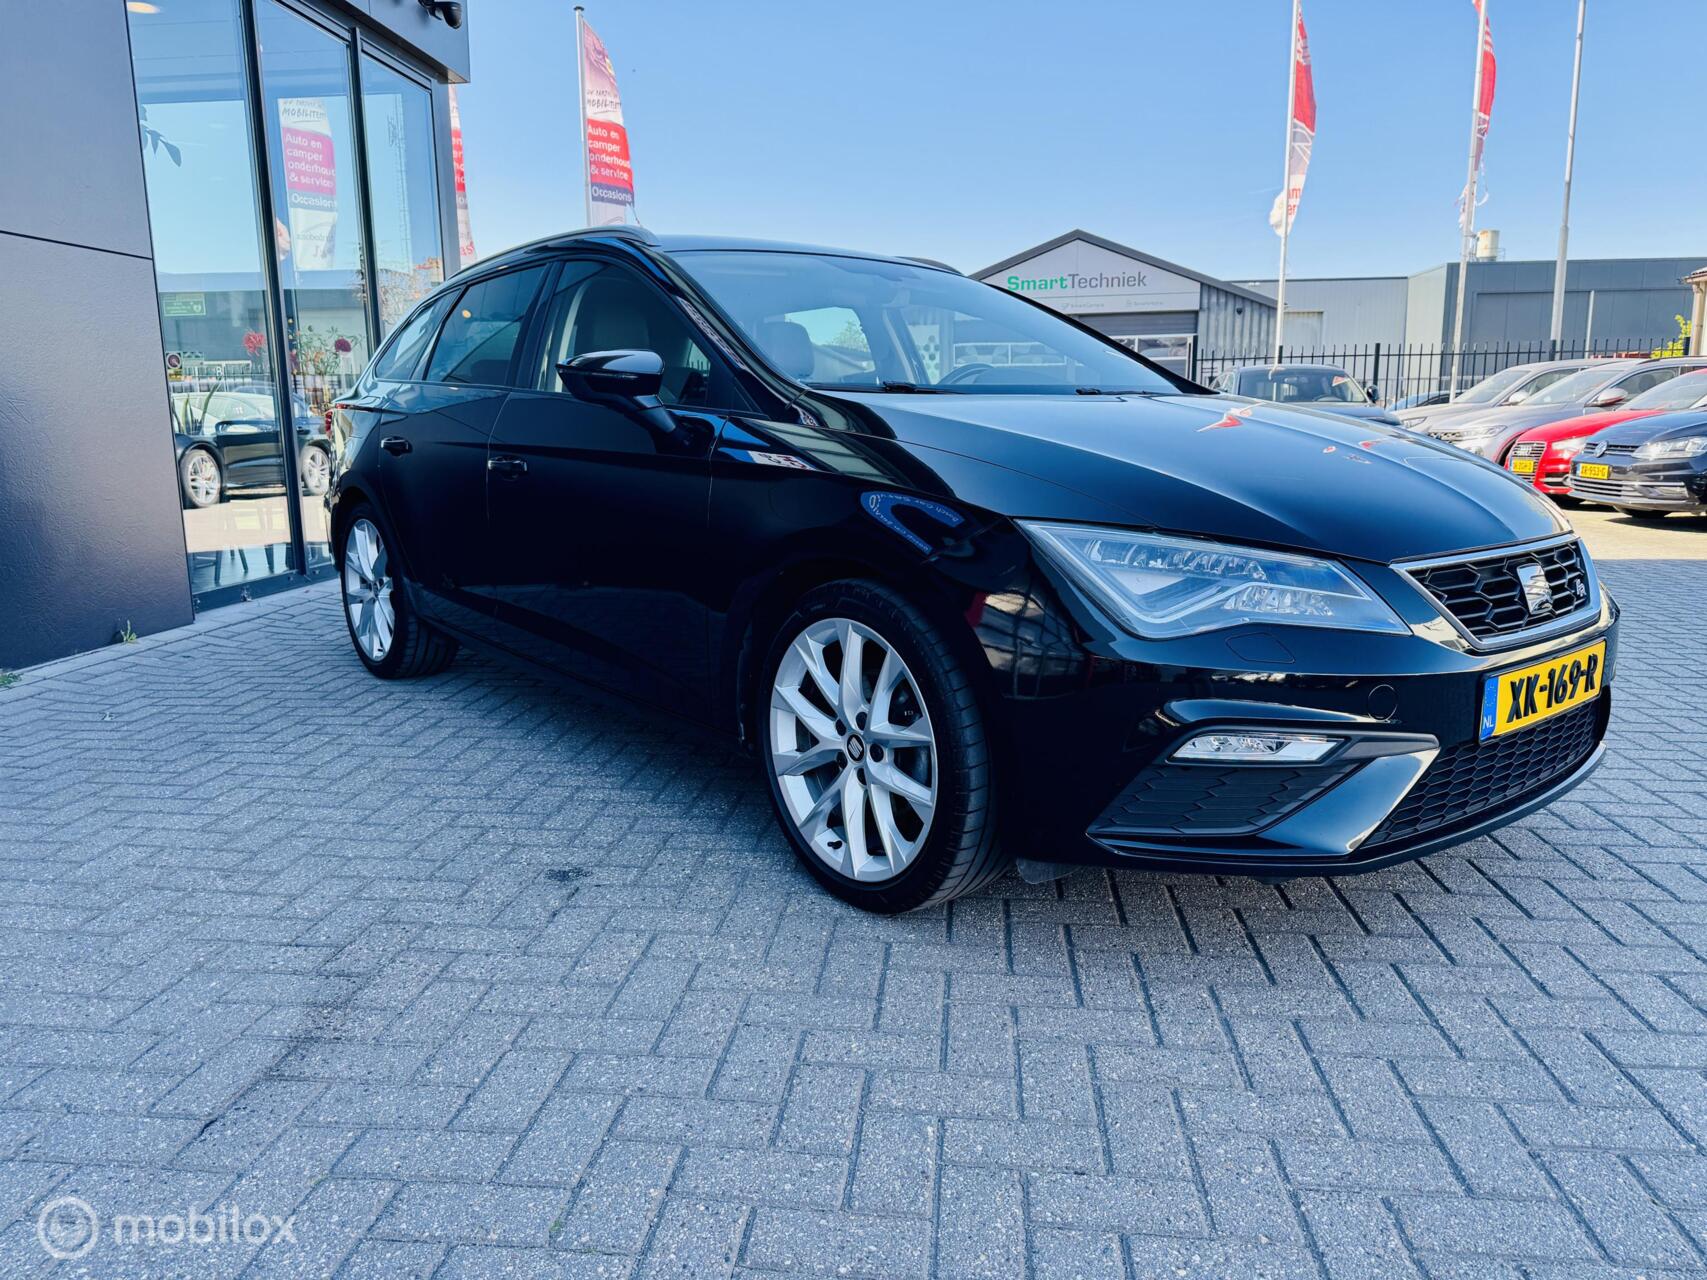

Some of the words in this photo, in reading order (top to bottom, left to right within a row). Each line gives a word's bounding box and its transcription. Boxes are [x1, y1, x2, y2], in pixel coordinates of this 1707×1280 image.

[588, 124, 608, 137] Auto
[286, 133, 308, 146] Auto
[311, 140, 322, 149] en
[588, 140, 621, 153] camper
[287, 149, 322, 161] camper
[289, 171, 299, 182] &
[590, 164, 599, 175] &
[601, 168, 629, 181] service
[592, 185, 632, 202] Occasions
[1007, 272, 1147, 292] SmartTechniek
[1506, 653, 1599, 723] XK-169-R
[1482, 715, 1494, 729] NL
